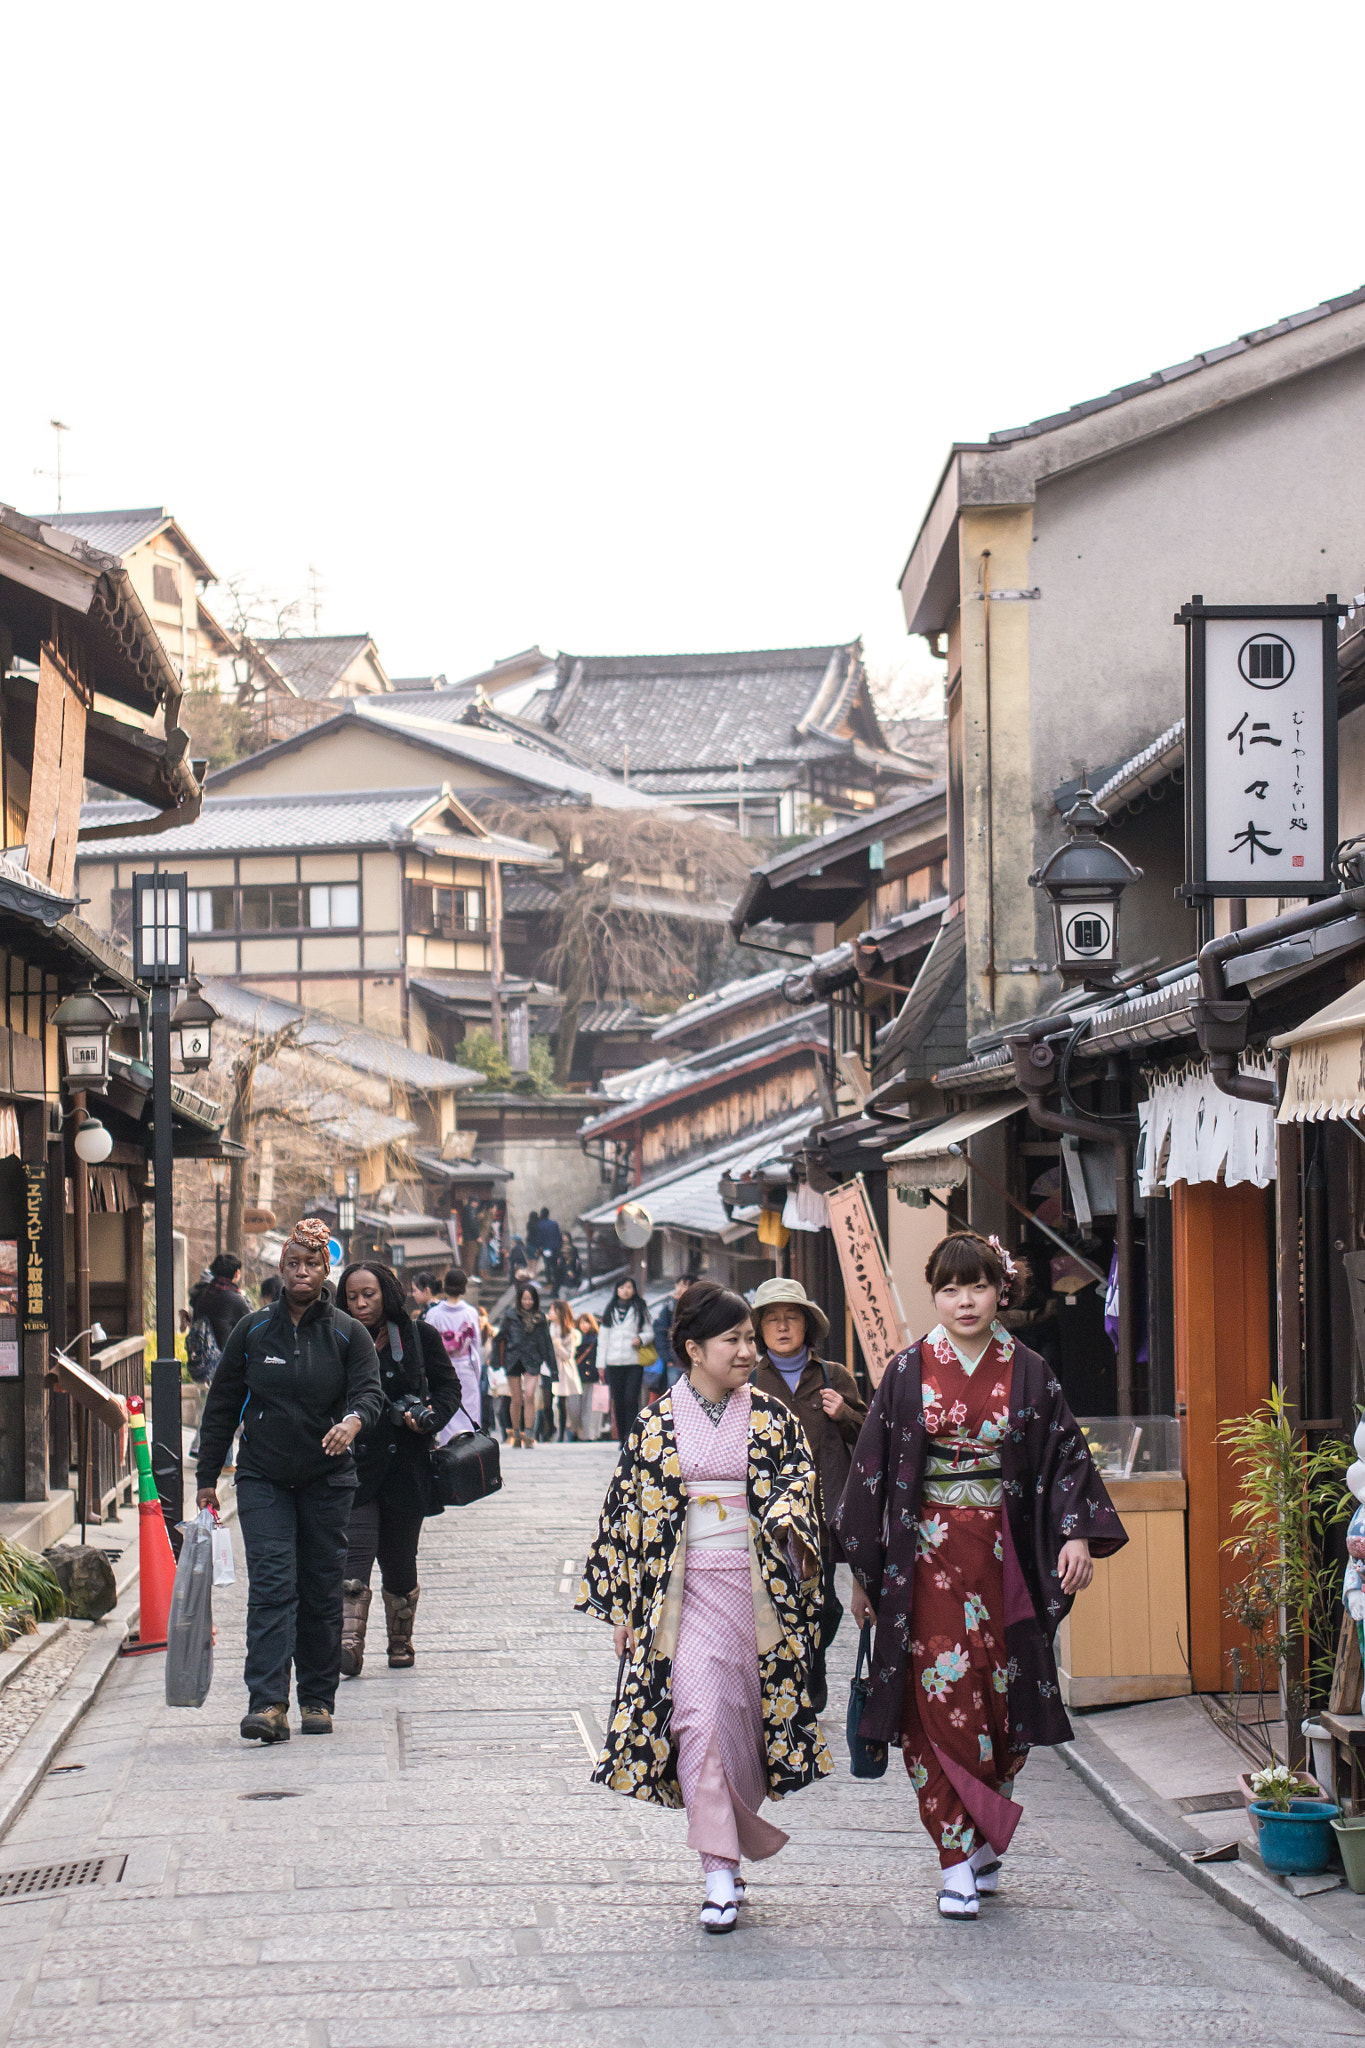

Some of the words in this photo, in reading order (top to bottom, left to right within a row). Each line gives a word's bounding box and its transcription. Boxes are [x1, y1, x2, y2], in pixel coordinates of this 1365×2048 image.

[1228, 711, 1282, 865] 仁々木
[1289, 711, 1308, 831] むしやしない処
